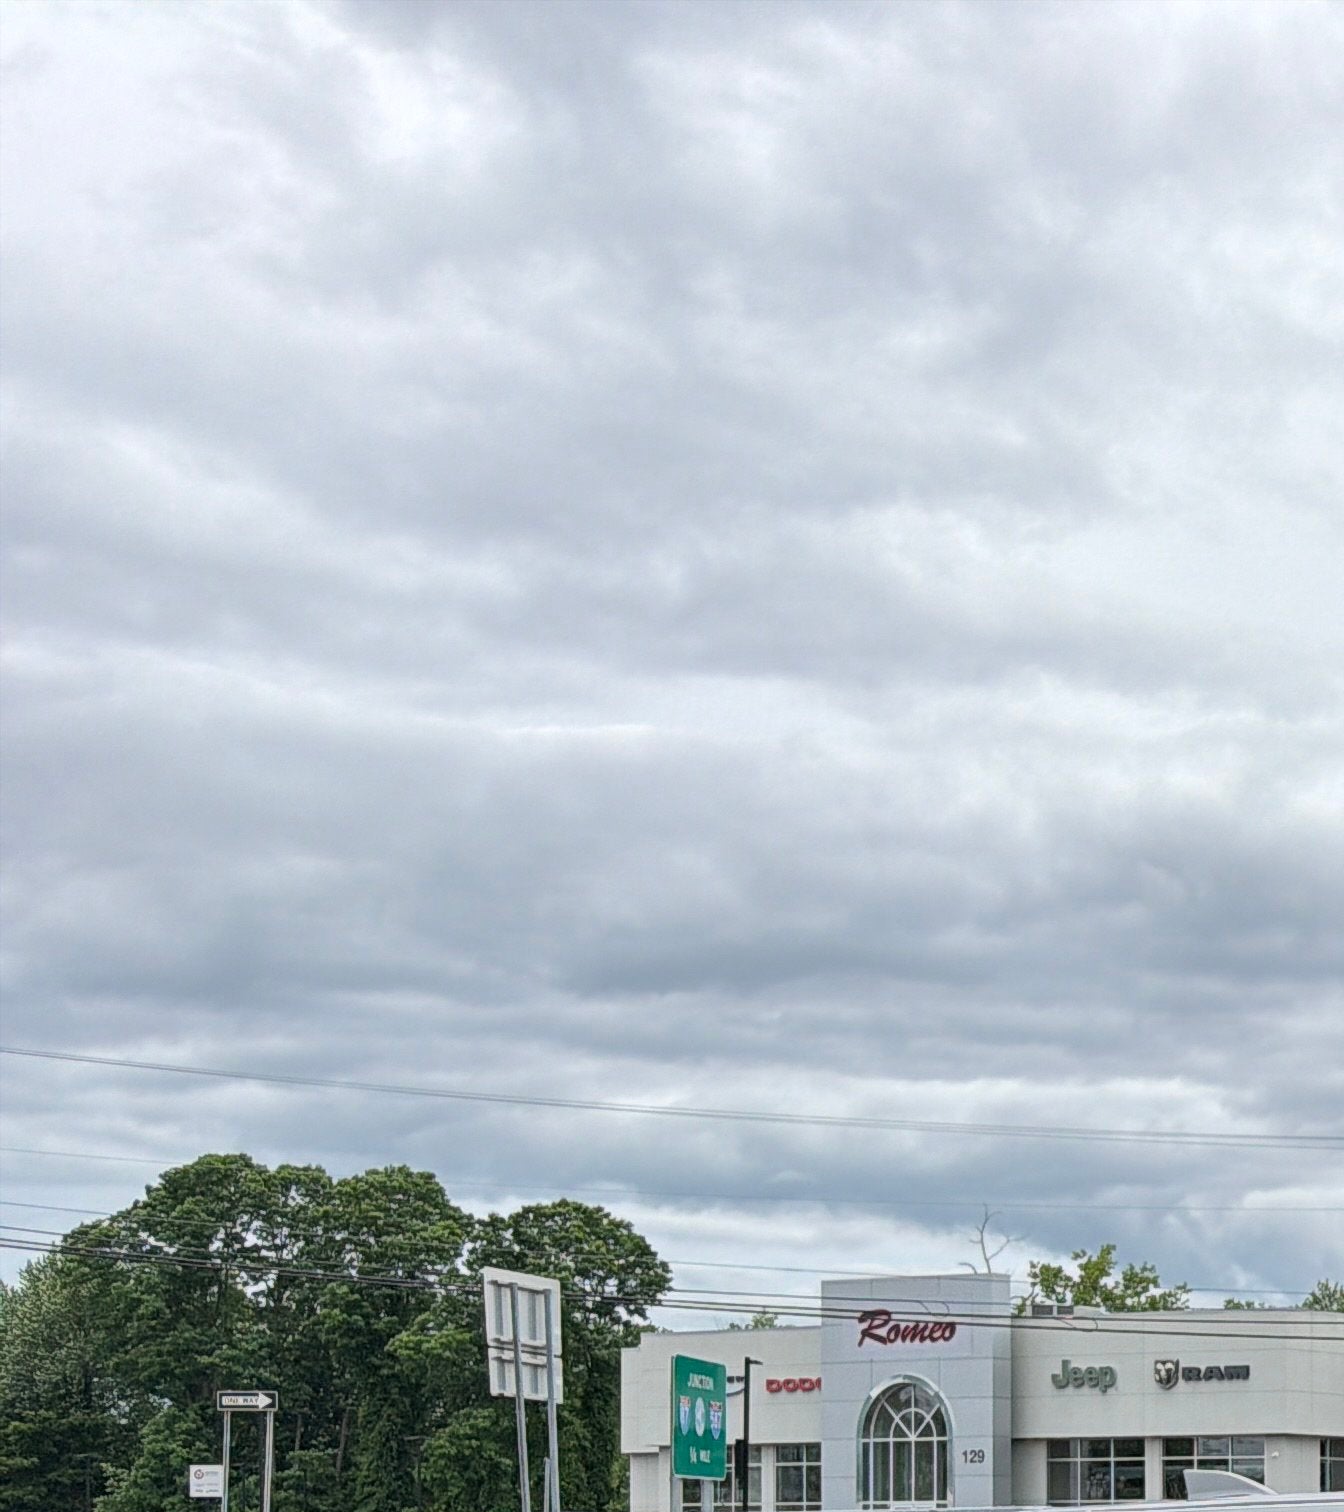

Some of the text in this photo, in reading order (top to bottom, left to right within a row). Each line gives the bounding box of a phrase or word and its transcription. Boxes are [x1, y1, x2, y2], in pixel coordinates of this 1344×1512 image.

[857, 1309, 957, 1348] Romeo
[1051, 1359, 1118, 1394] Jeep
[1182, 1365, 1250, 1382] RAM
[242, 1397, 260, 1405] WAY
[961, 1449, 985, 1464] 129
